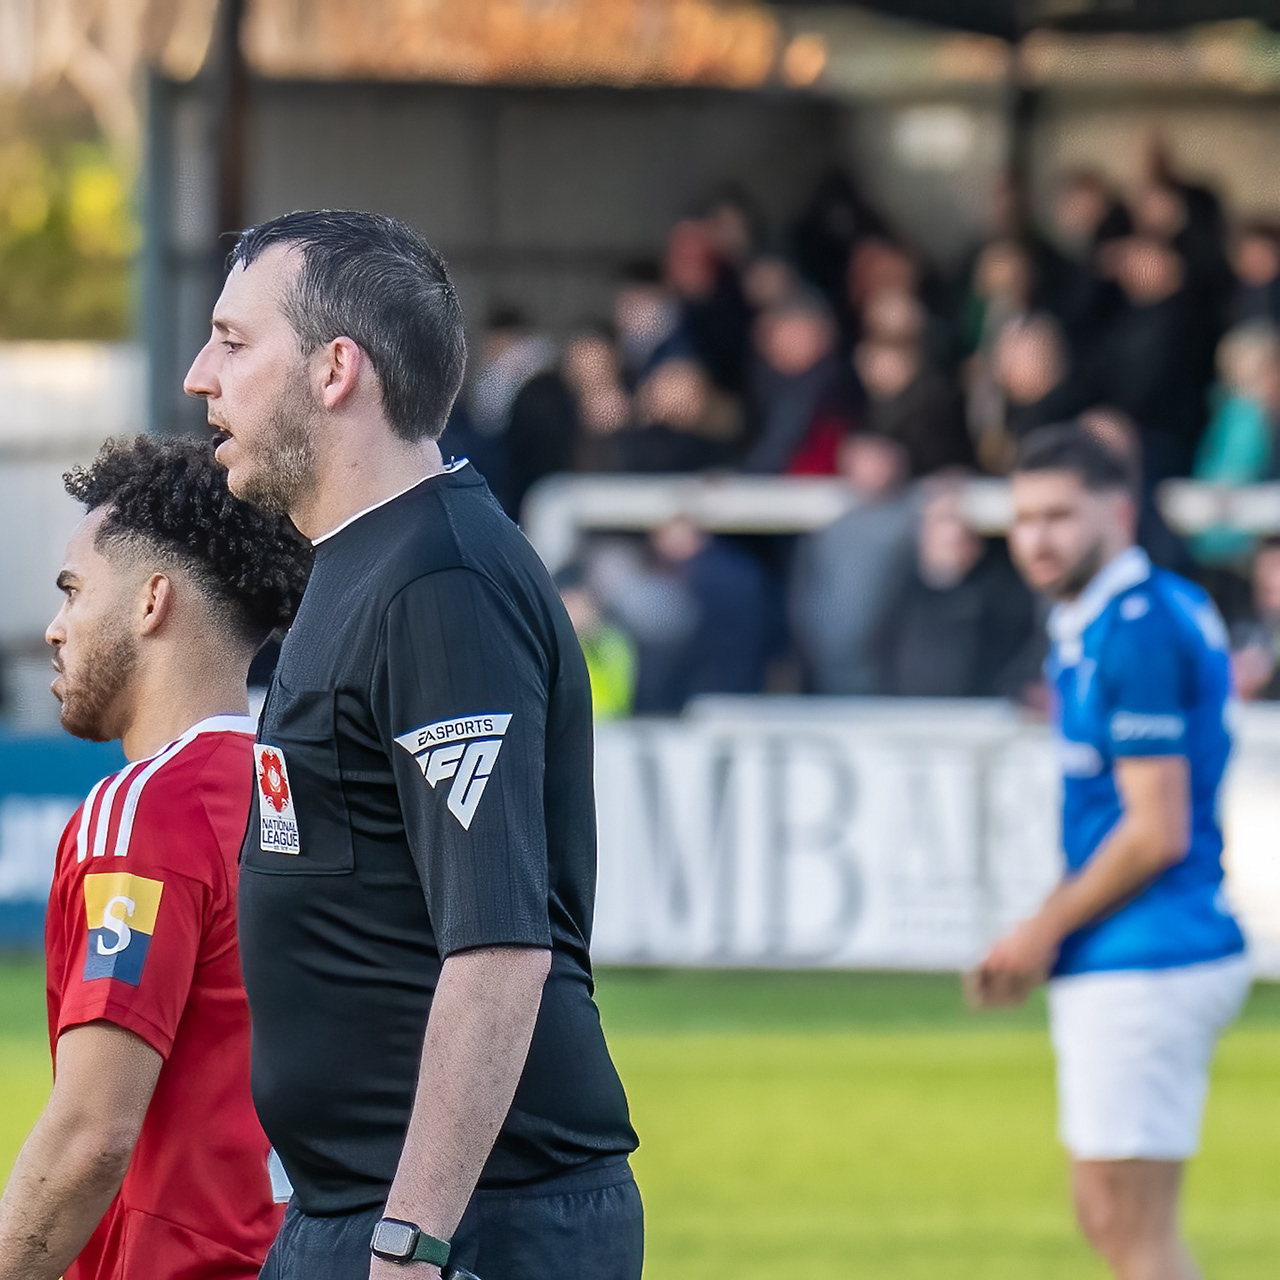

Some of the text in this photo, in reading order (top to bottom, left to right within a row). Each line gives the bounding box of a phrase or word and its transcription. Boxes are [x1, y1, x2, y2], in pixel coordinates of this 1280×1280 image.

[436, 719, 494, 740] SPORTS
[262, 818, 297, 833] NATIONAL
[262, 830, 299, 847] LEAGUE
[96, 895, 136, 956] S
